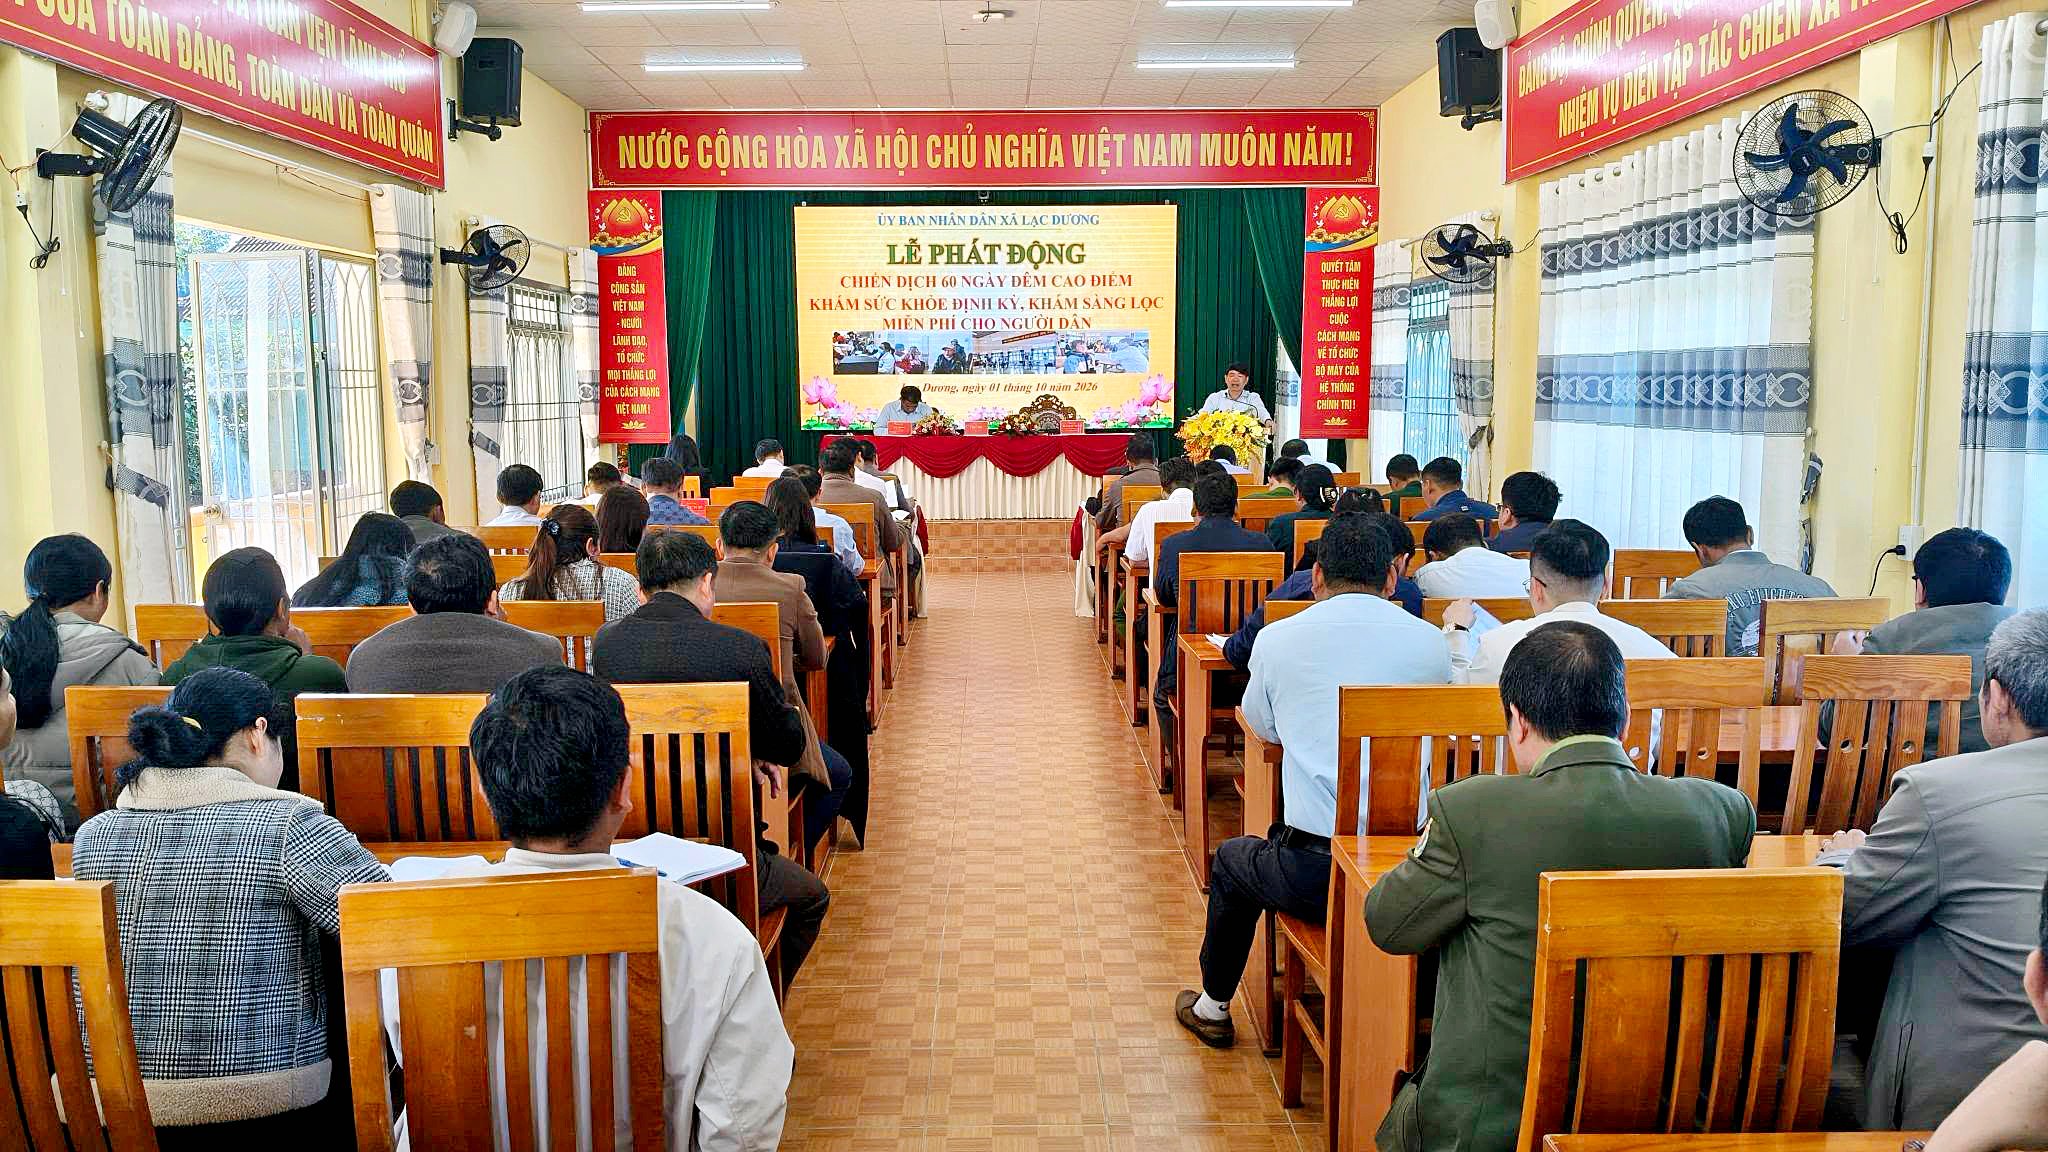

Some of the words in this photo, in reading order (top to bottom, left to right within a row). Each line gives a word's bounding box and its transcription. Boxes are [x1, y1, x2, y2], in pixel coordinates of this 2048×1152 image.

[1519, 50, 1547, 98] ĐẢNG
[1558, 86, 1599, 138] NHIỆM
[1602, 79, 1620, 125] VỤ
[1663, 38, 1694, 100] TẬP
[1699, 19, 1733, 78] TÁC
[176, 16, 243, 96] ĐẢNG,
[247, 55, 296, 111] TOÀN
[300, 75, 334, 126] DÂN
[337, 89, 358, 134] VÀ
[360, 102, 397, 149] TOÀN
[400, 120, 433, 163] QUÂN
[618, 128, 689, 169] NƯỚC
[697, 129, 768, 176] CỘNG
[776, 127, 827, 169] HÒA
[834, 128, 869, 169] XÃ
[876, 128, 918, 176] HỘI
[926, 123, 976, 169] CHỦ
[984, 128, 1065, 169] NGHĨA
[1071, 128, 1126, 175] VIỆT
[1133, 133, 1192, 168] NAM
[1200, 125, 1276, 168] MUÔN
[1283, 126, 1353, 167] NĂM!
[878, 212, 896, 226] ỦY
[899, 215, 925, 226] BAN
[929, 212, 966, 226] NHÂN
[969, 212, 997, 226] DÂN
[1000, 212, 1018, 226] XÃ
[1022, 214, 1048, 228] LẠC
[1052, 213, 1100, 226] DƯƠNG
[886, 237, 922, 265] LỄ
[928, 237, 1001, 265] PHÁT
[1006, 240, 1087, 270] ĐỘNG
[610, 281, 630, 296] CỘNG
[631, 280, 645, 294] SẢN
[840, 272, 891, 289] CHIẾN
[896, 275, 937, 291] DỊCH
[941, 275, 957, 288] 60
[961, 271, 1007, 288] NGÀY
[1051, 274, 1086, 287] CAO
[612, 298, 627, 313] VIỆT
[628, 300, 645, 311] NAM
[809, 295, 859, 311] KHÁM
[864, 295, 896, 311] SỨC
[901, 295, 948, 311] KHỎE
[952, 298, 992, 313] ĐỊNH
[1029, 293, 1078, 310] KHÁM
[1082, 293, 1126, 310] SÀNG
[1131, 296, 1164, 312] LỌC
[929, 314, 956, 330] PHÍ
[961, 317, 996, 330] CHO
[1000, 315, 1053, 330] NGƯỜI
[1059, 313, 1092, 330] DÂN
[1329, 312, 1349, 326] CUỘC
[1317, 329, 1337, 342] CÁCH
[1327, 364, 1344, 375] MÁY
[620, 385, 638, 397] CÁCH
[962, 383, 987, 395] ngày
[989, 382, 1000, 392] 01
[1003, 382, 1032, 394] tháng
[1035, 382, 1047, 392] 10
[1049, 383, 1071, 392] năm
[1074, 382, 1098, 392] 2026
[615, 402, 630, 416] VIỆT
[1316, 398, 1339, 410] CHÍNH
